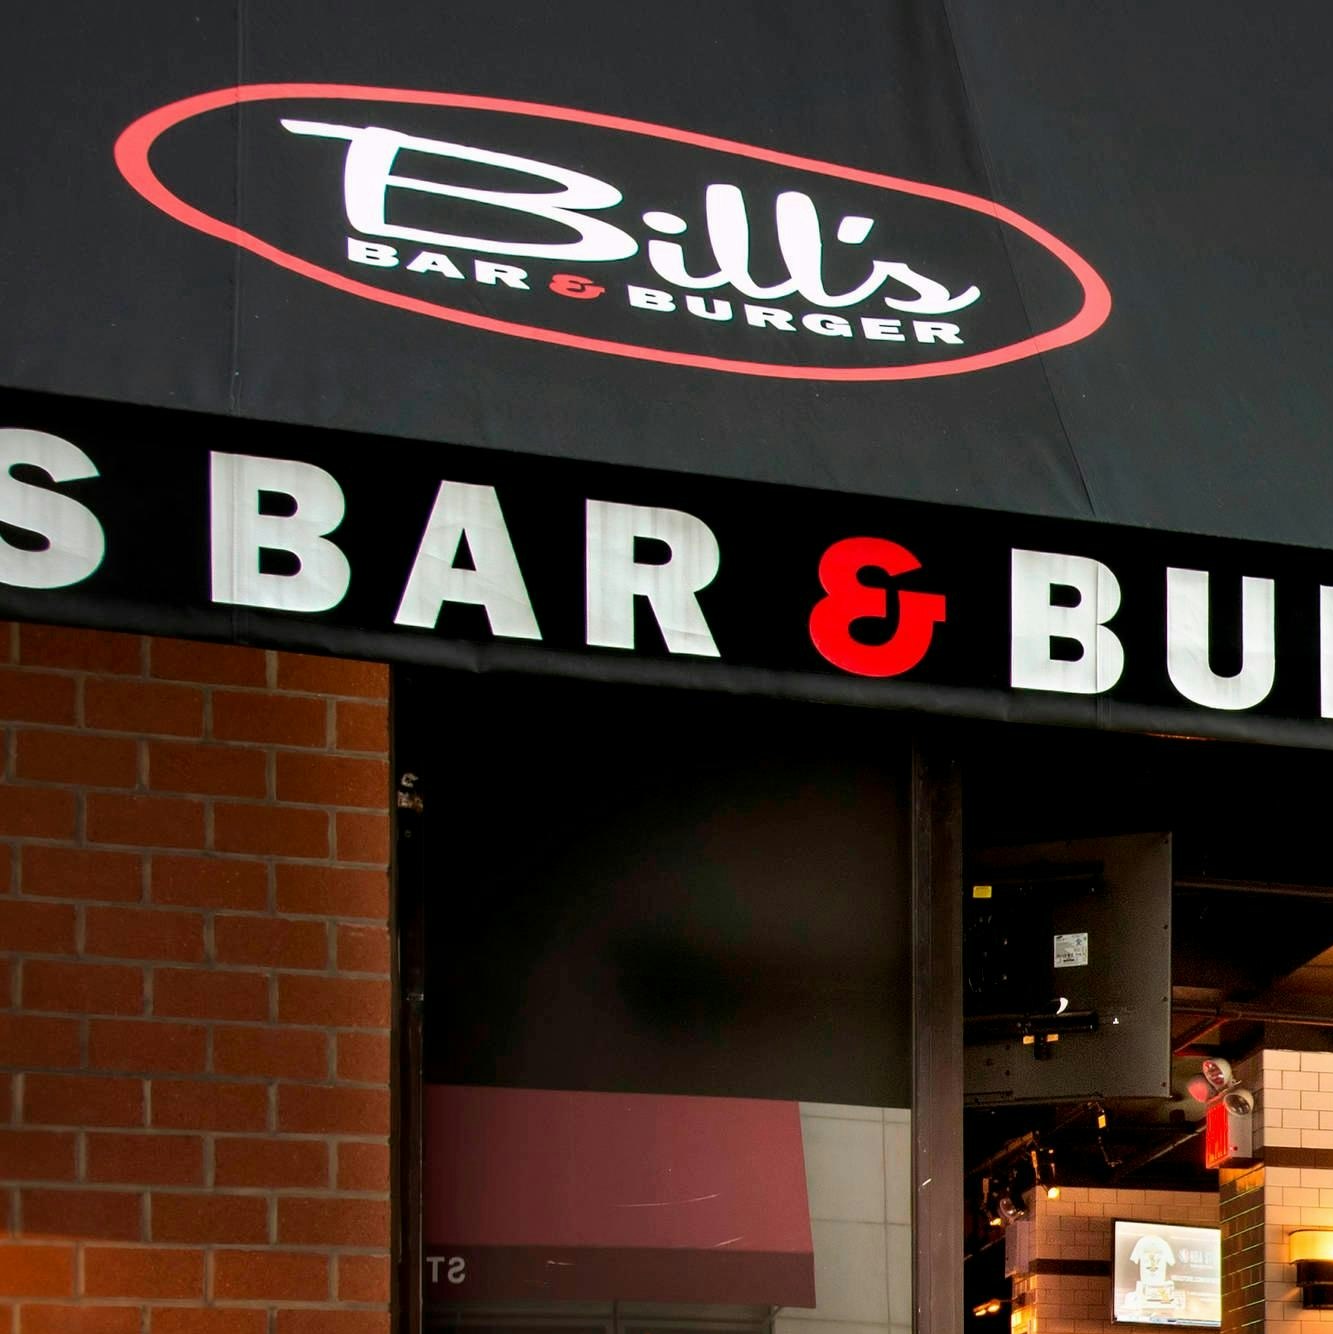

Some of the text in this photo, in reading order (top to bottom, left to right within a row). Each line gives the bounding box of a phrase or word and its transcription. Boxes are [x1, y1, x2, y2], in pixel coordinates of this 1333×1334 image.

[279, 118, 980, 313] Bill's
[346, 235, 965, 346] BAR & BURGER
[207, 449, 730, 658] BAR
[807, 535, 948, 678] &
